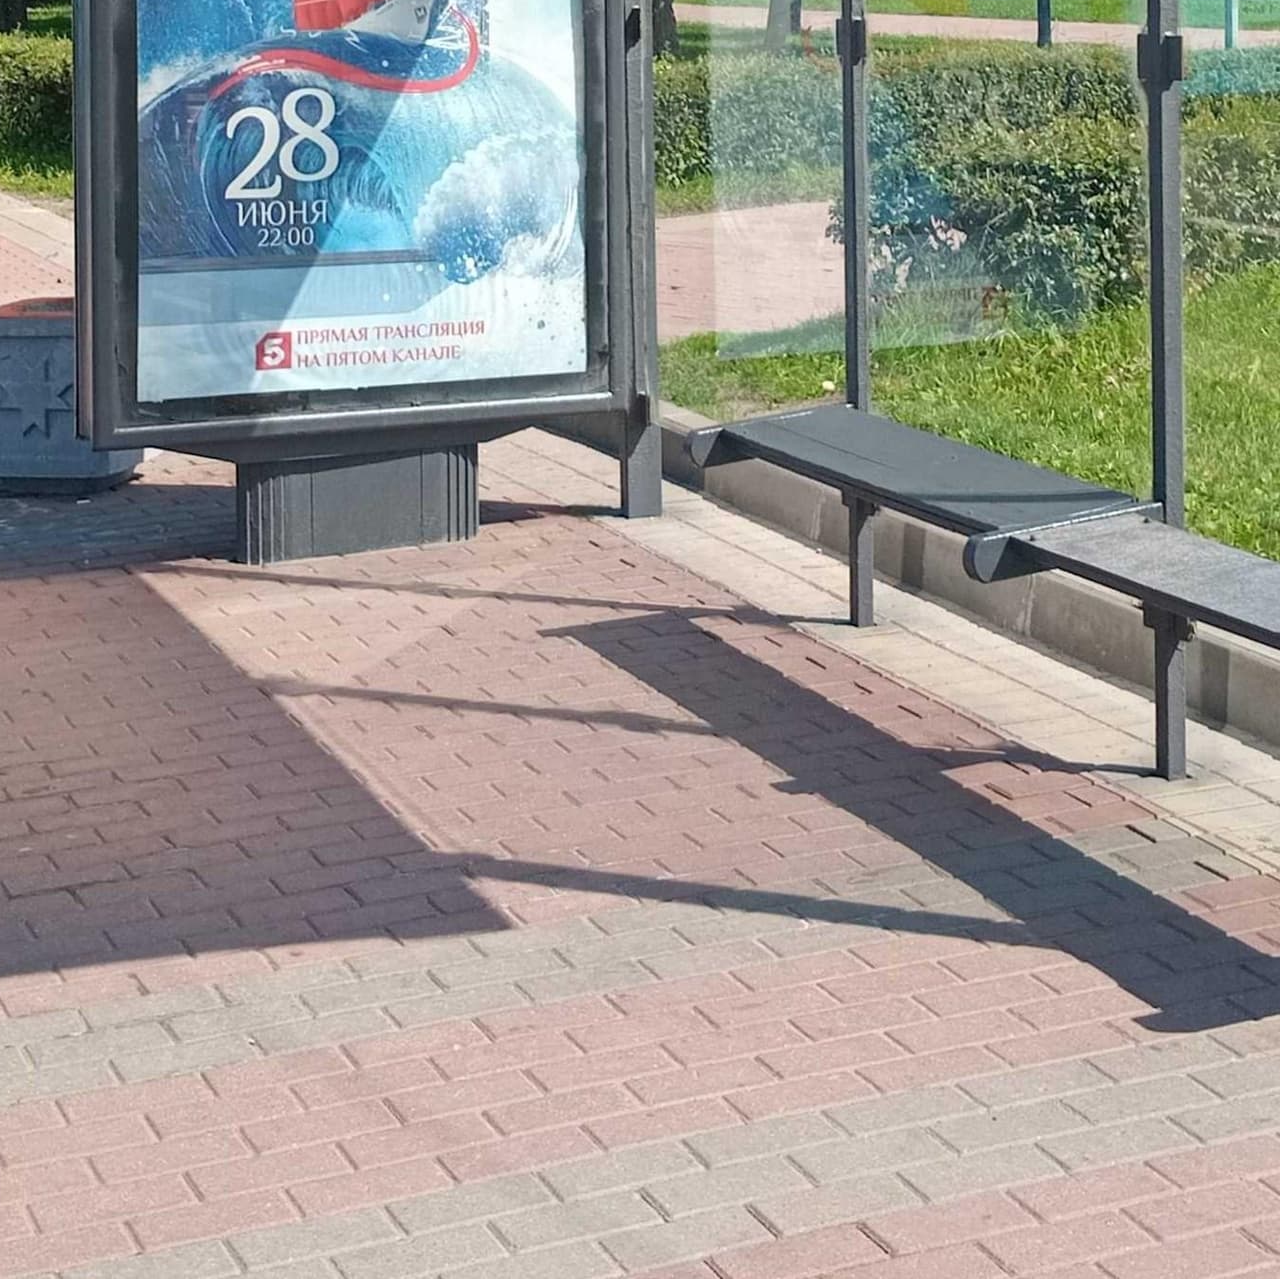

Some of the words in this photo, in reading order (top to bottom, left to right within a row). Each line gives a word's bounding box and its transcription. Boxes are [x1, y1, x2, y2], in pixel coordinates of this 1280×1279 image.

[224, 87, 340, 200] 28
[235, 199, 330, 227] ИЮНЯ
[257, 226, 315, 248] 22:00
[297, 328, 369, 345] ПРЯМАЯ
[373, 320, 486, 341] ТРАНСЛЯЦИЯ
[297, 353, 322, 368] НА
[326, 349, 386, 367] ПЯТОМ
[392, 344, 461, 362] КАНАЛЕ
